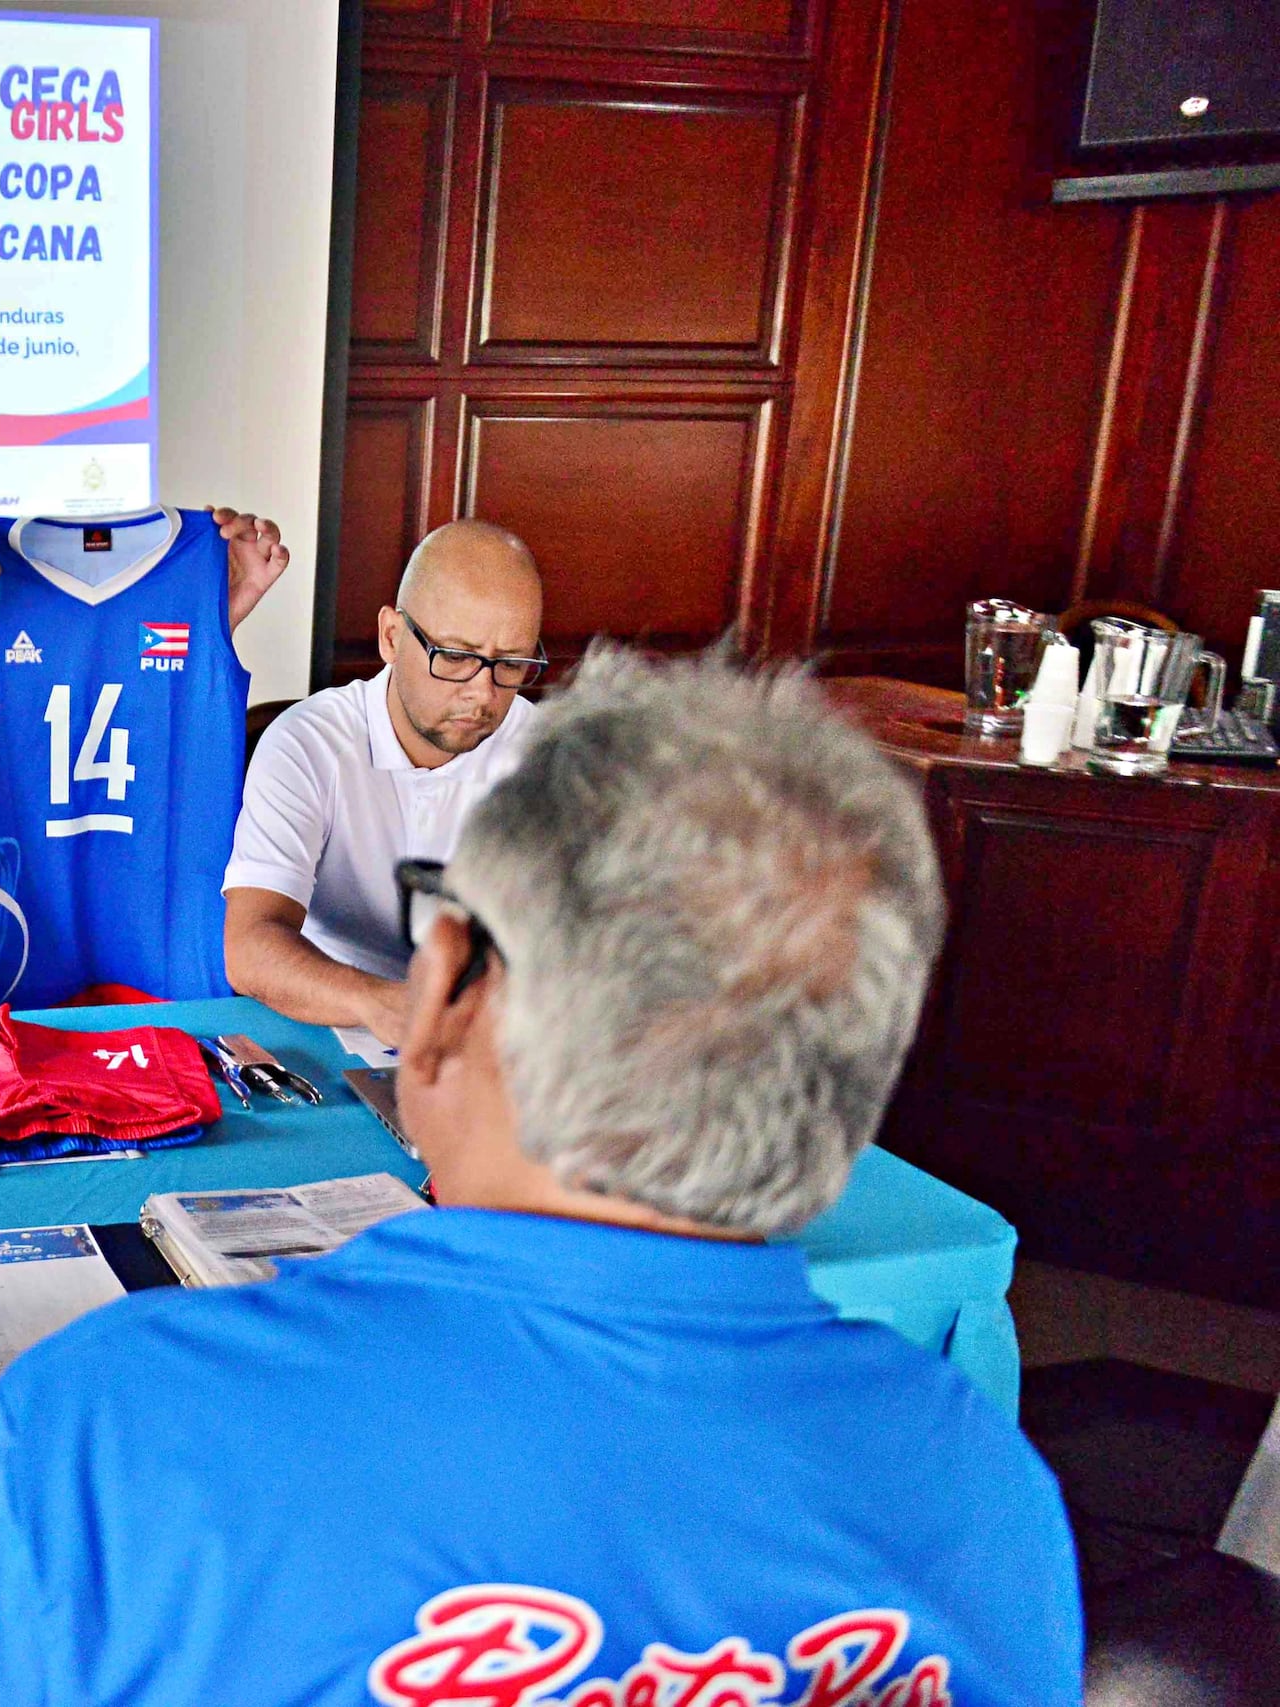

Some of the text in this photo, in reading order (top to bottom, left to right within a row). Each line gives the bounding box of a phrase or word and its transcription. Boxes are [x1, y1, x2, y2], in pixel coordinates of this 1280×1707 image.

[11, 100, 125, 143] GIRLS
[0, 163, 102, 201] COPA
[23, 338, 80, 359] junio,
[5, 648, 43, 664] PEAK
[140, 657, 184, 671] PUR
[43, 683, 136, 805] 14
